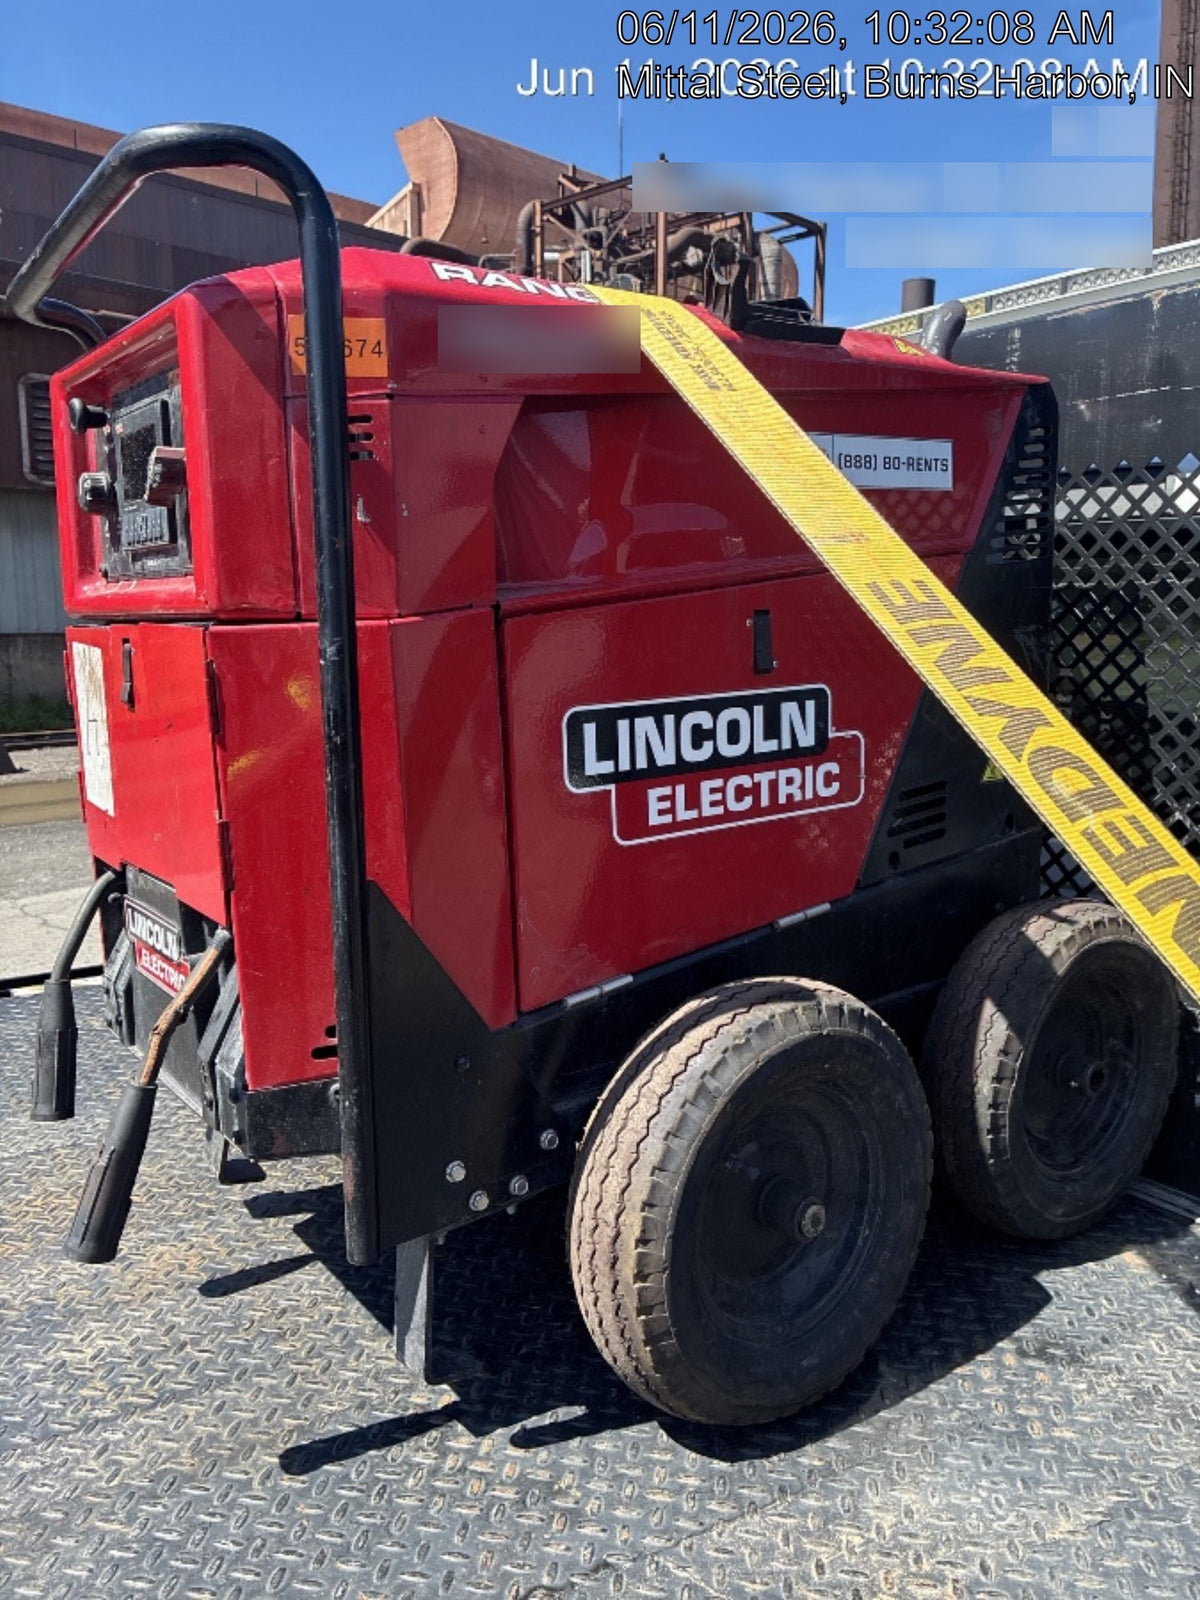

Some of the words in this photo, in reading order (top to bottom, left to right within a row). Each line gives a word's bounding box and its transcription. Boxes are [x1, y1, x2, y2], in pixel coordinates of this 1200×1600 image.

[838, 452, 878, 472] (888)
[583, 699, 816, 776] LINCOLN
[647, 761, 841, 826] ELECTRIC
[126, 907, 181, 962] LINCOLN
